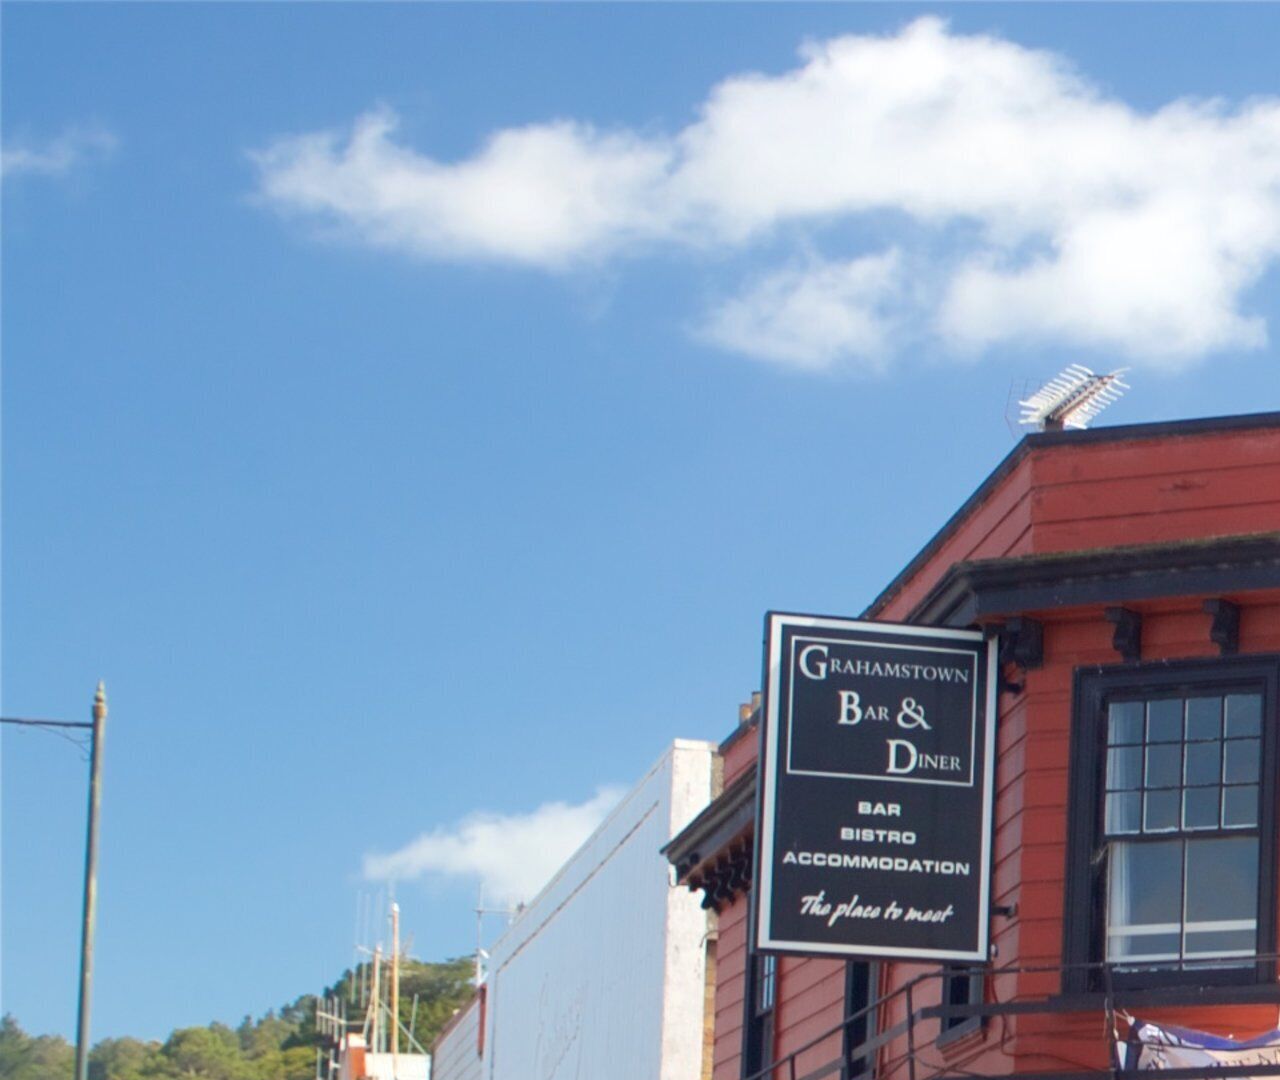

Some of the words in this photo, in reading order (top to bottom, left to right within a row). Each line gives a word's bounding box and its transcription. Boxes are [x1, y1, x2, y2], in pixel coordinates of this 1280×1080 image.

[799, 644, 969, 683] GRAHAMSTOWN
[838, 690, 889, 725] BAR
[896, 697, 932, 730] &
[886, 739, 961, 775] DINER
[857, 801, 901, 817] BAR
[840, 827, 917, 845] BISTRO
[782, 851, 970, 876] ACCOMMODATION
[800, 891, 832, 916] The
[828, 894, 881, 928] place
[883, 901, 902, 921] to
[904, 905, 954, 924] meet
